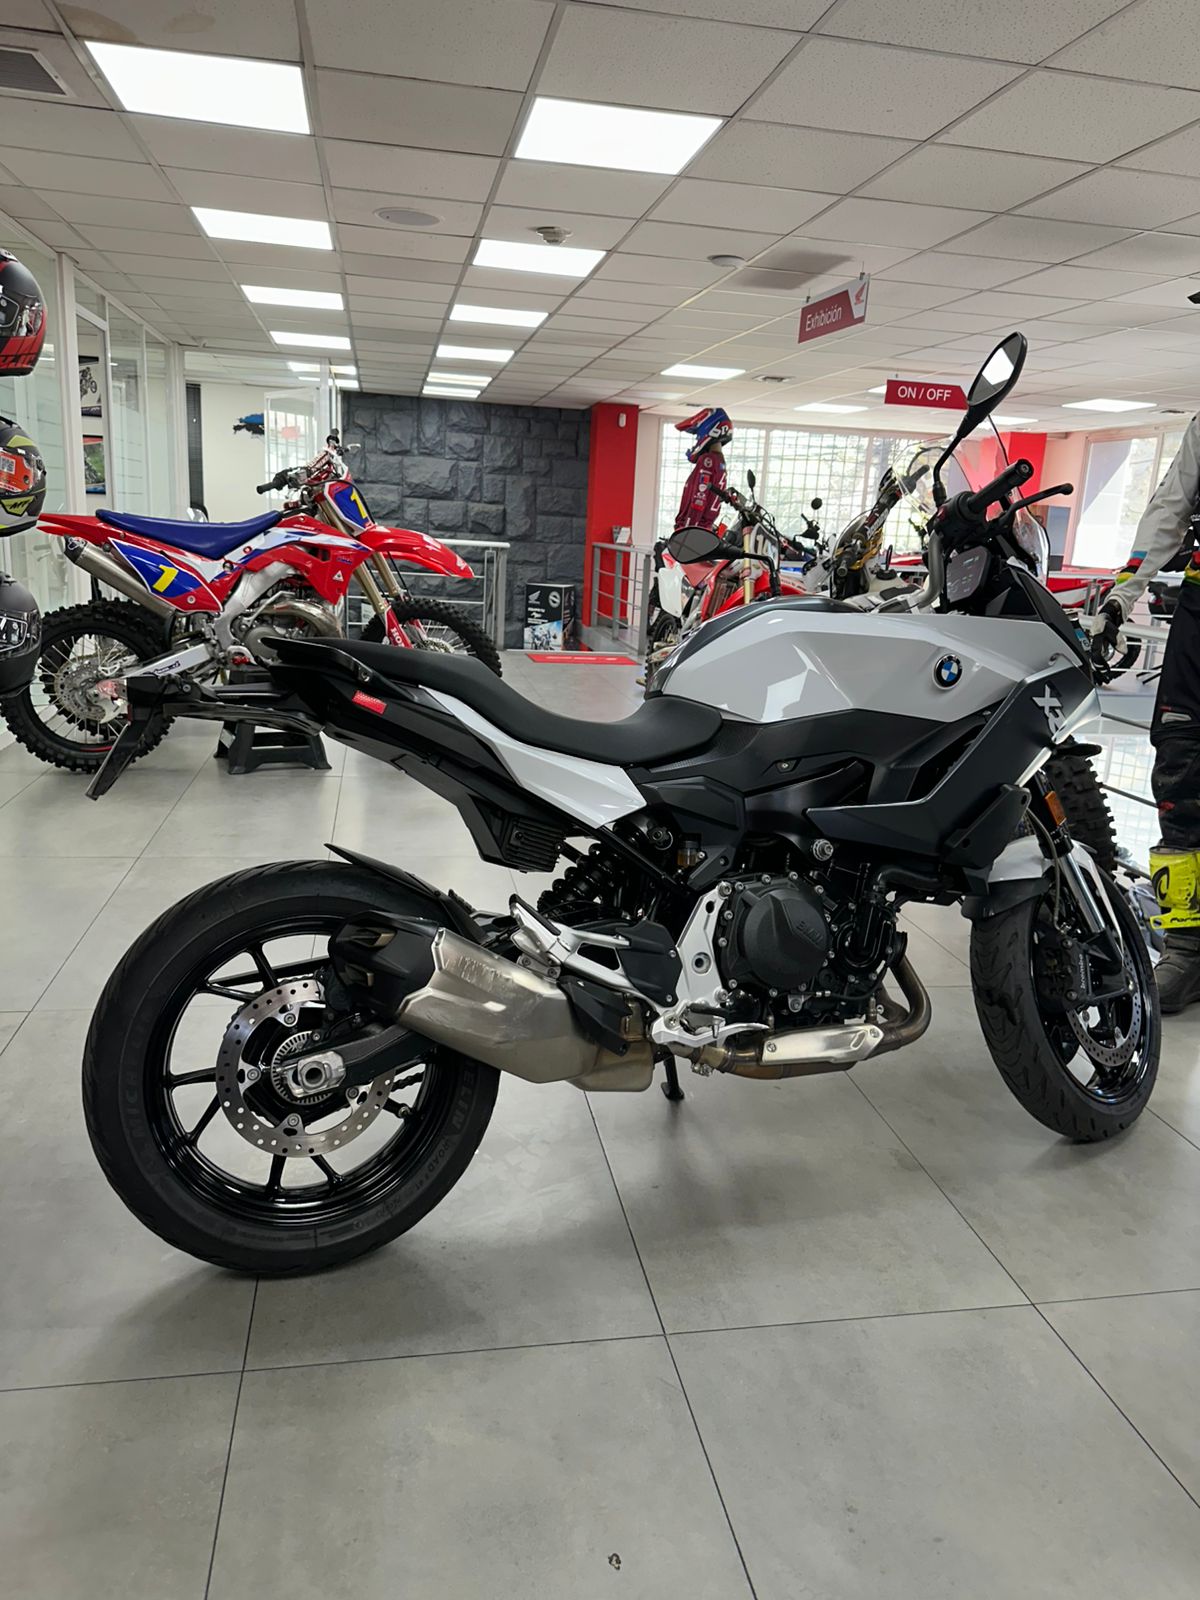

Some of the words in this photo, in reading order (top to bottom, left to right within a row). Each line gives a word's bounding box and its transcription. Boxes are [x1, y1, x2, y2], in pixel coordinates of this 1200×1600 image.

[805, 304, 842, 332] Exhibición
[897, 385, 916, 400] ON
[918, 387, 924, 400] /
[926, 388, 952, 402] OFF
[349, 489, 370, 519] 1
[152, 564, 179, 593] 1
